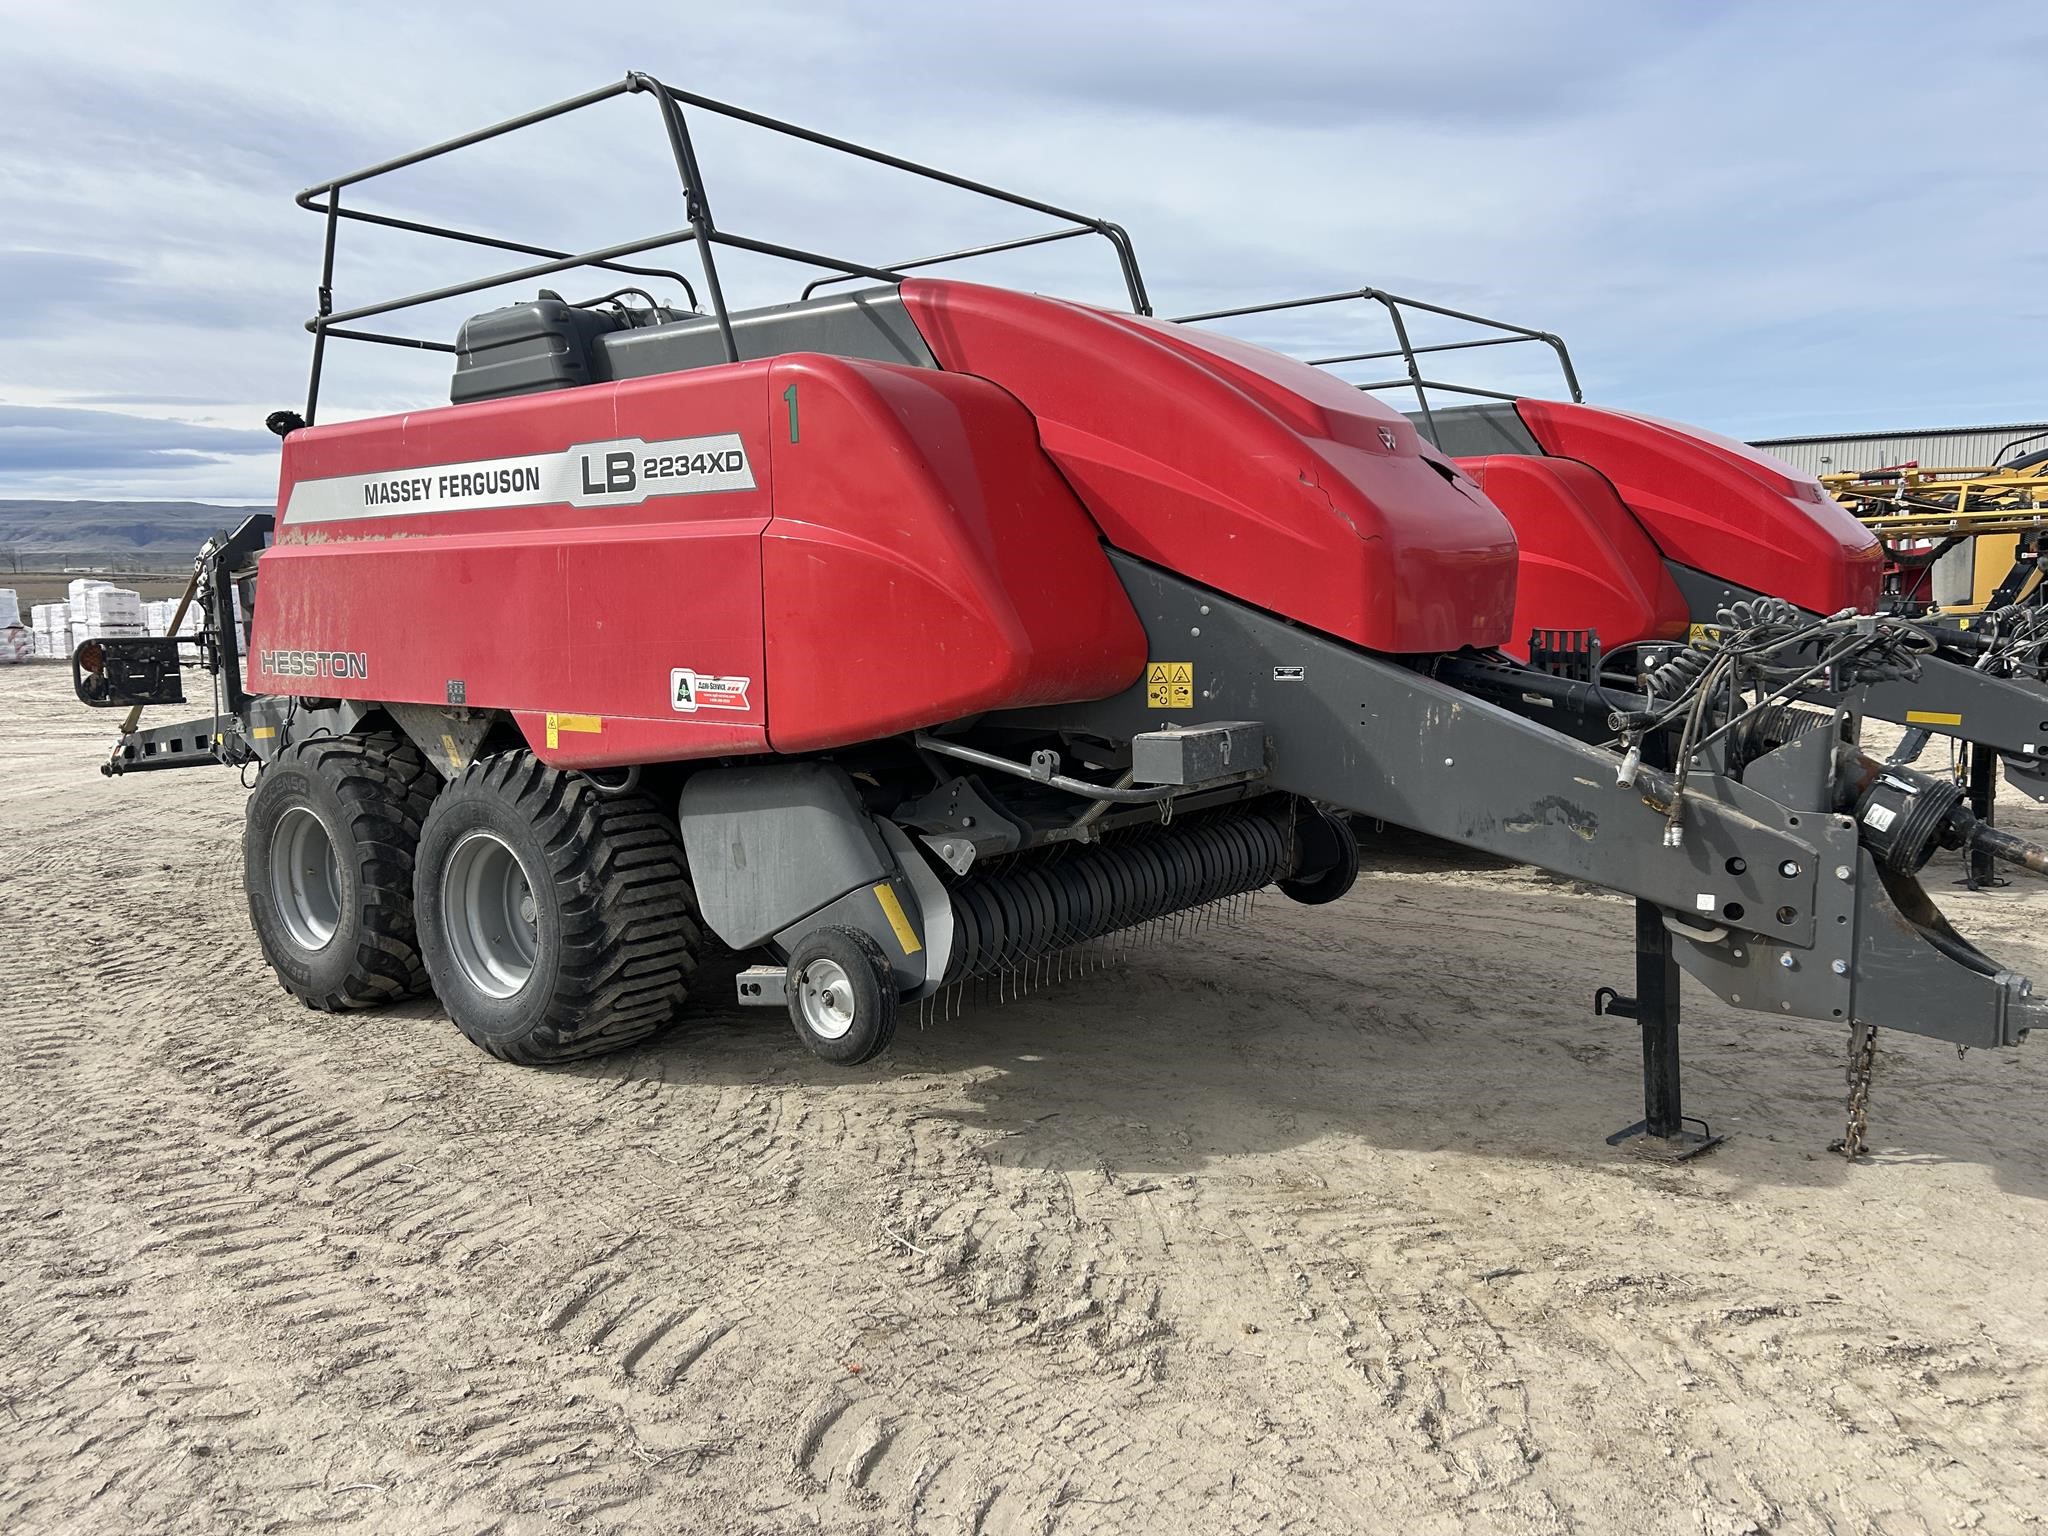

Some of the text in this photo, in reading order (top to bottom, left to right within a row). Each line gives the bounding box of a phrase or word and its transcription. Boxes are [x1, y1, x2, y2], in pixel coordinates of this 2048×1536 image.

[784, 384, 799, 444] 1
[364, 450, 744, 506] MASSEY FERGUSON LB 2234XD
[261, 650, 368, 679] HESSTON
[677, 678, 692, 702] A
